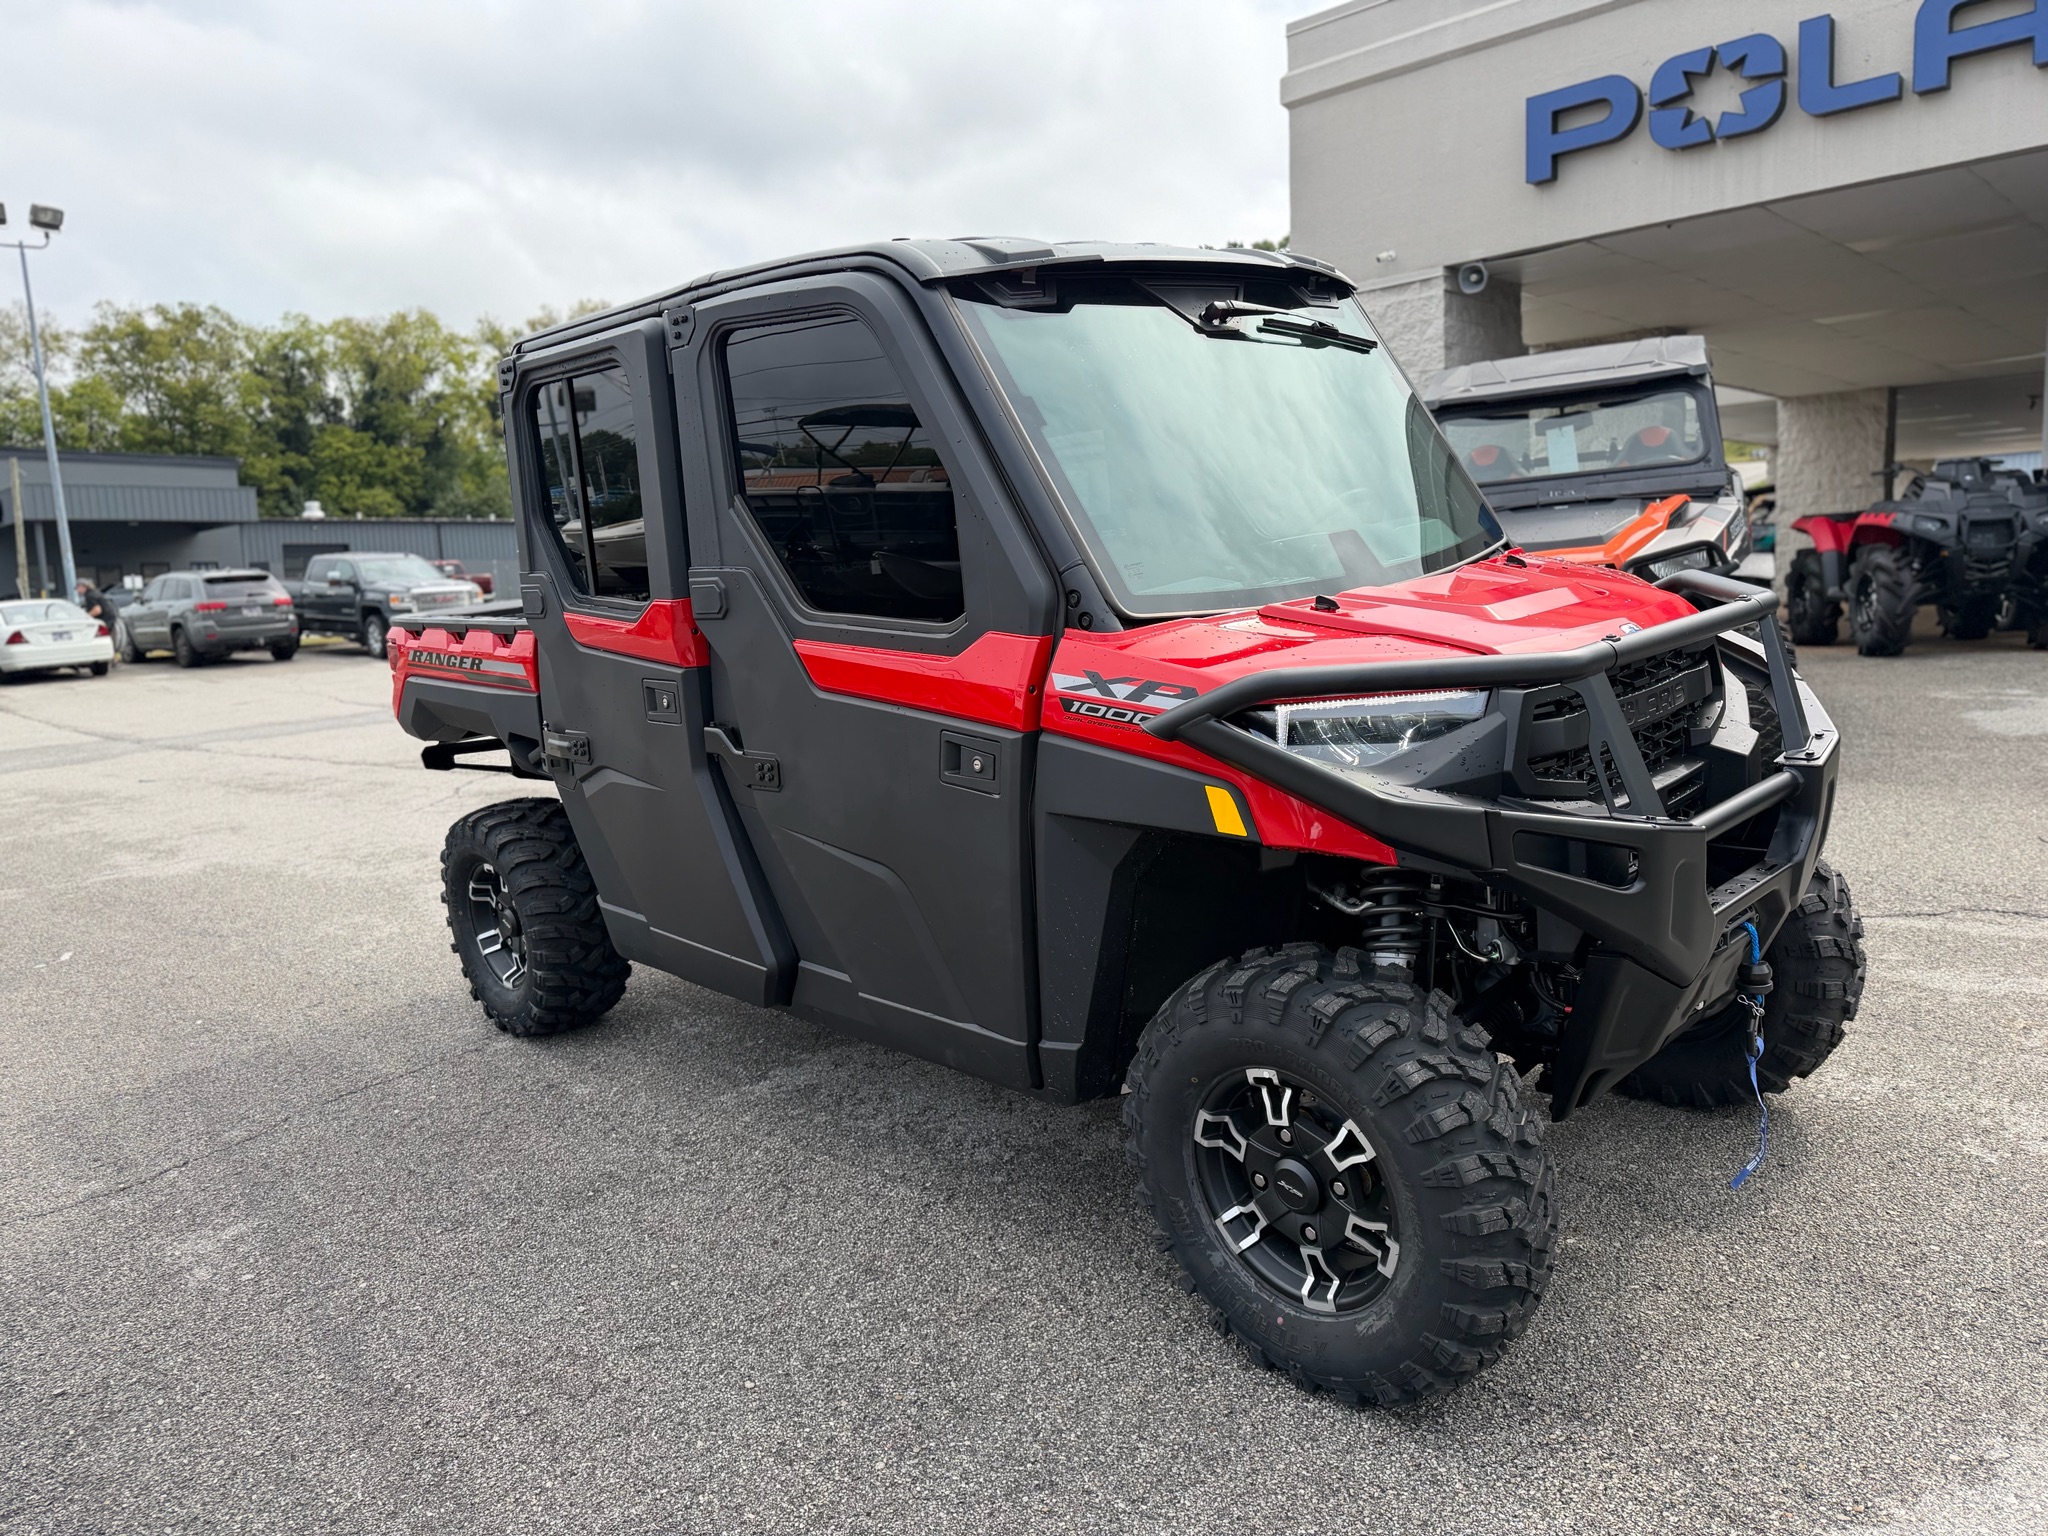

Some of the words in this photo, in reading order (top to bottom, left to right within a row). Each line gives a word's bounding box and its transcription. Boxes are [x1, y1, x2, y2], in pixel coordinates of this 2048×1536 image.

[1526, 0, 2048, 186] POLA
[411, 649, 484, 671] RANGER
[1059, 669, 1200, 703] XP
[1620, 681, 1686, 726] OLARIS
[1064, 715, 1084, 723] DUAL
[1086, 719, 1132, 732] OVERHEAD
